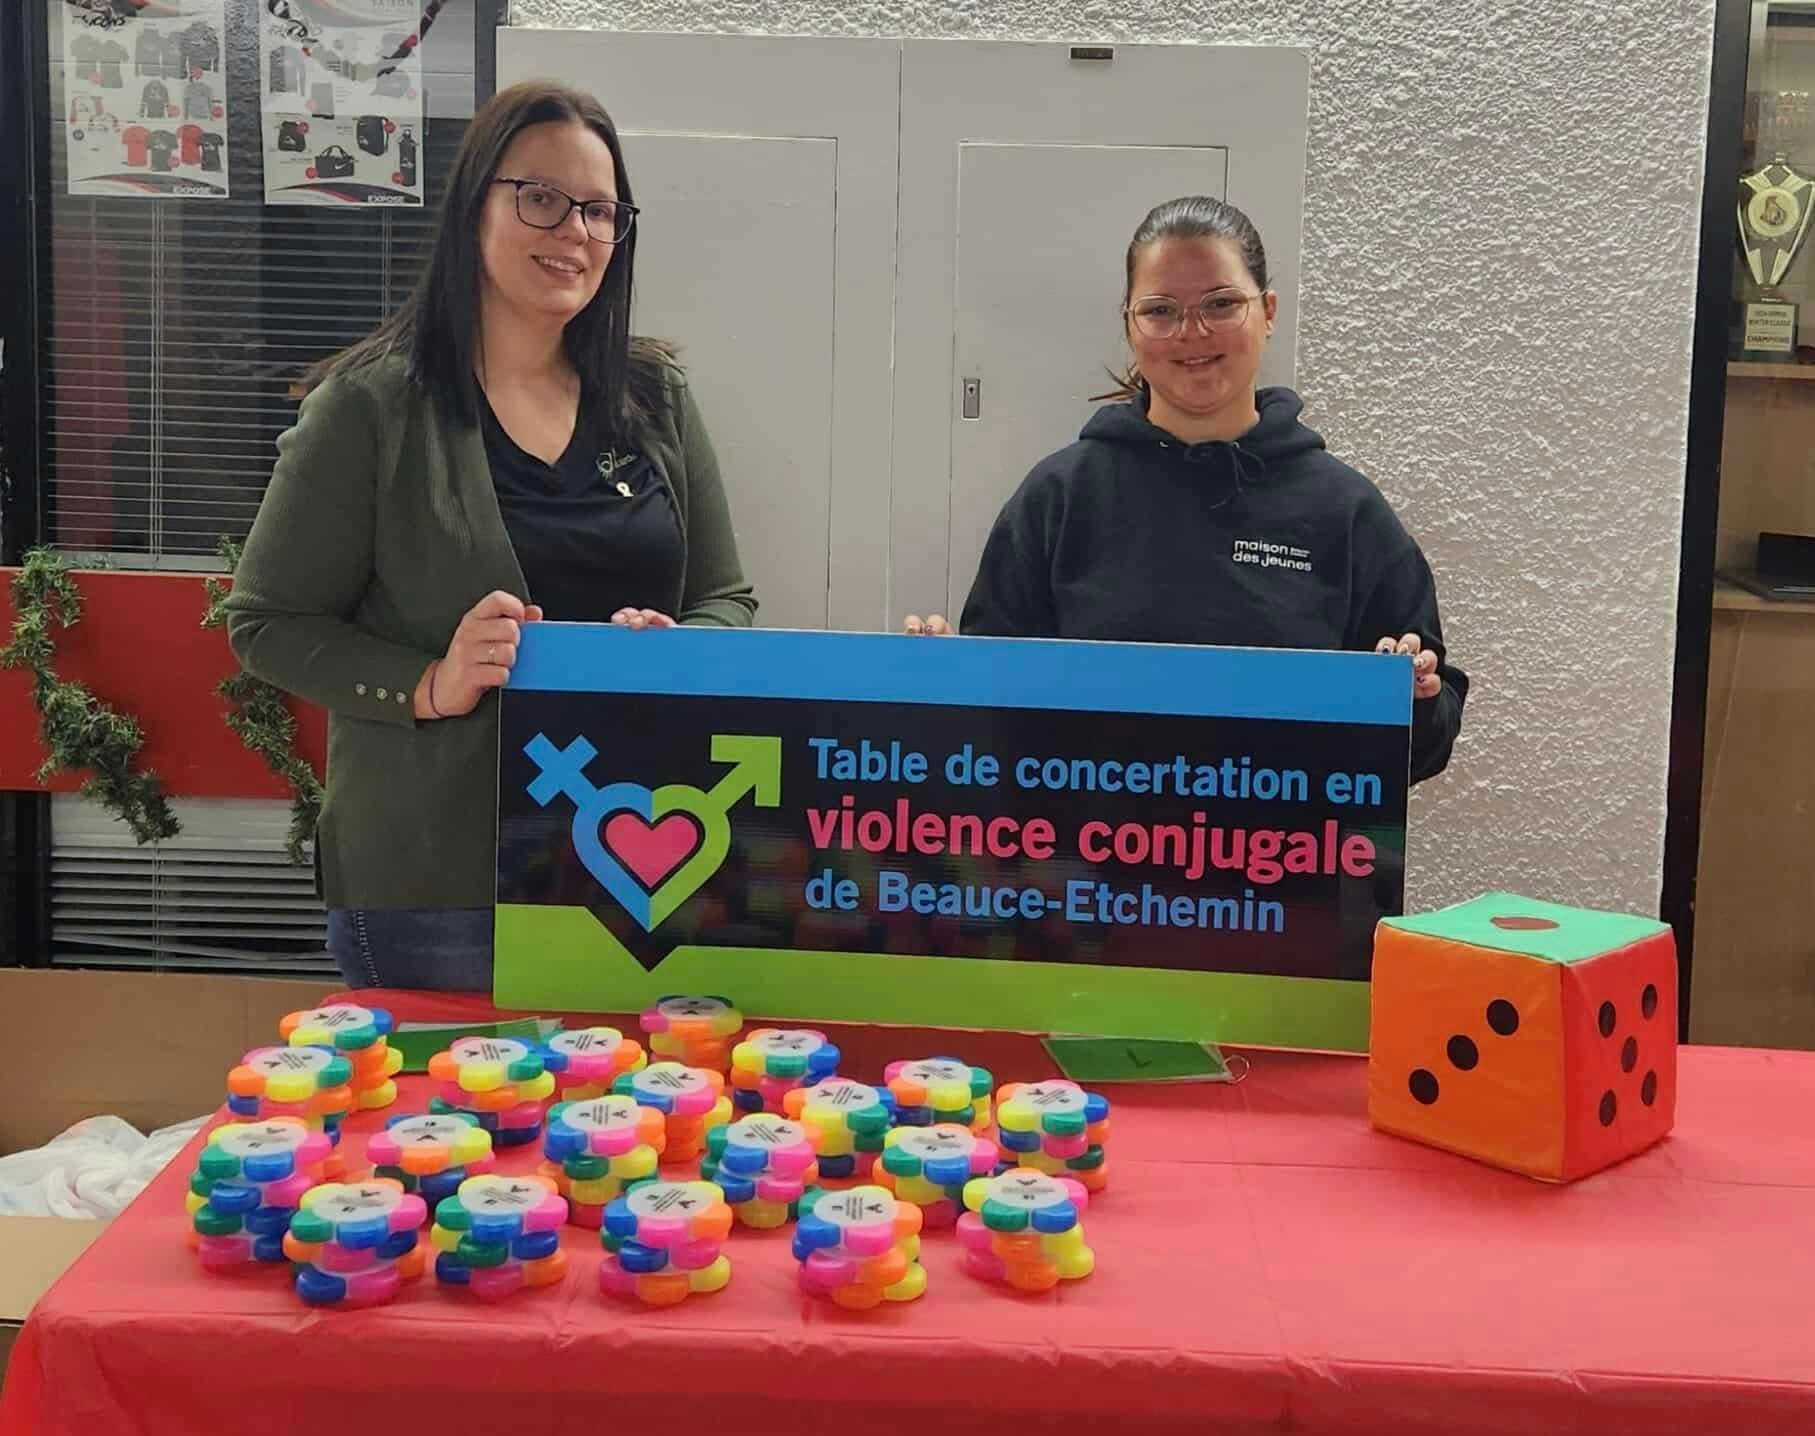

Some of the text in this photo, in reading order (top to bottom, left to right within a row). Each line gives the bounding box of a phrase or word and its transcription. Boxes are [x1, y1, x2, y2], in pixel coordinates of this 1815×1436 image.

[1232, 551, 1312, 571] des jeunes
[1234, 540, 1288, 555] maison
[808, 738, 1383, 806] Table de concertation en
[807, 795, 1377, 885] violence conjugale
[805, 868, 1285, 933] de Beauce-Etchemin
